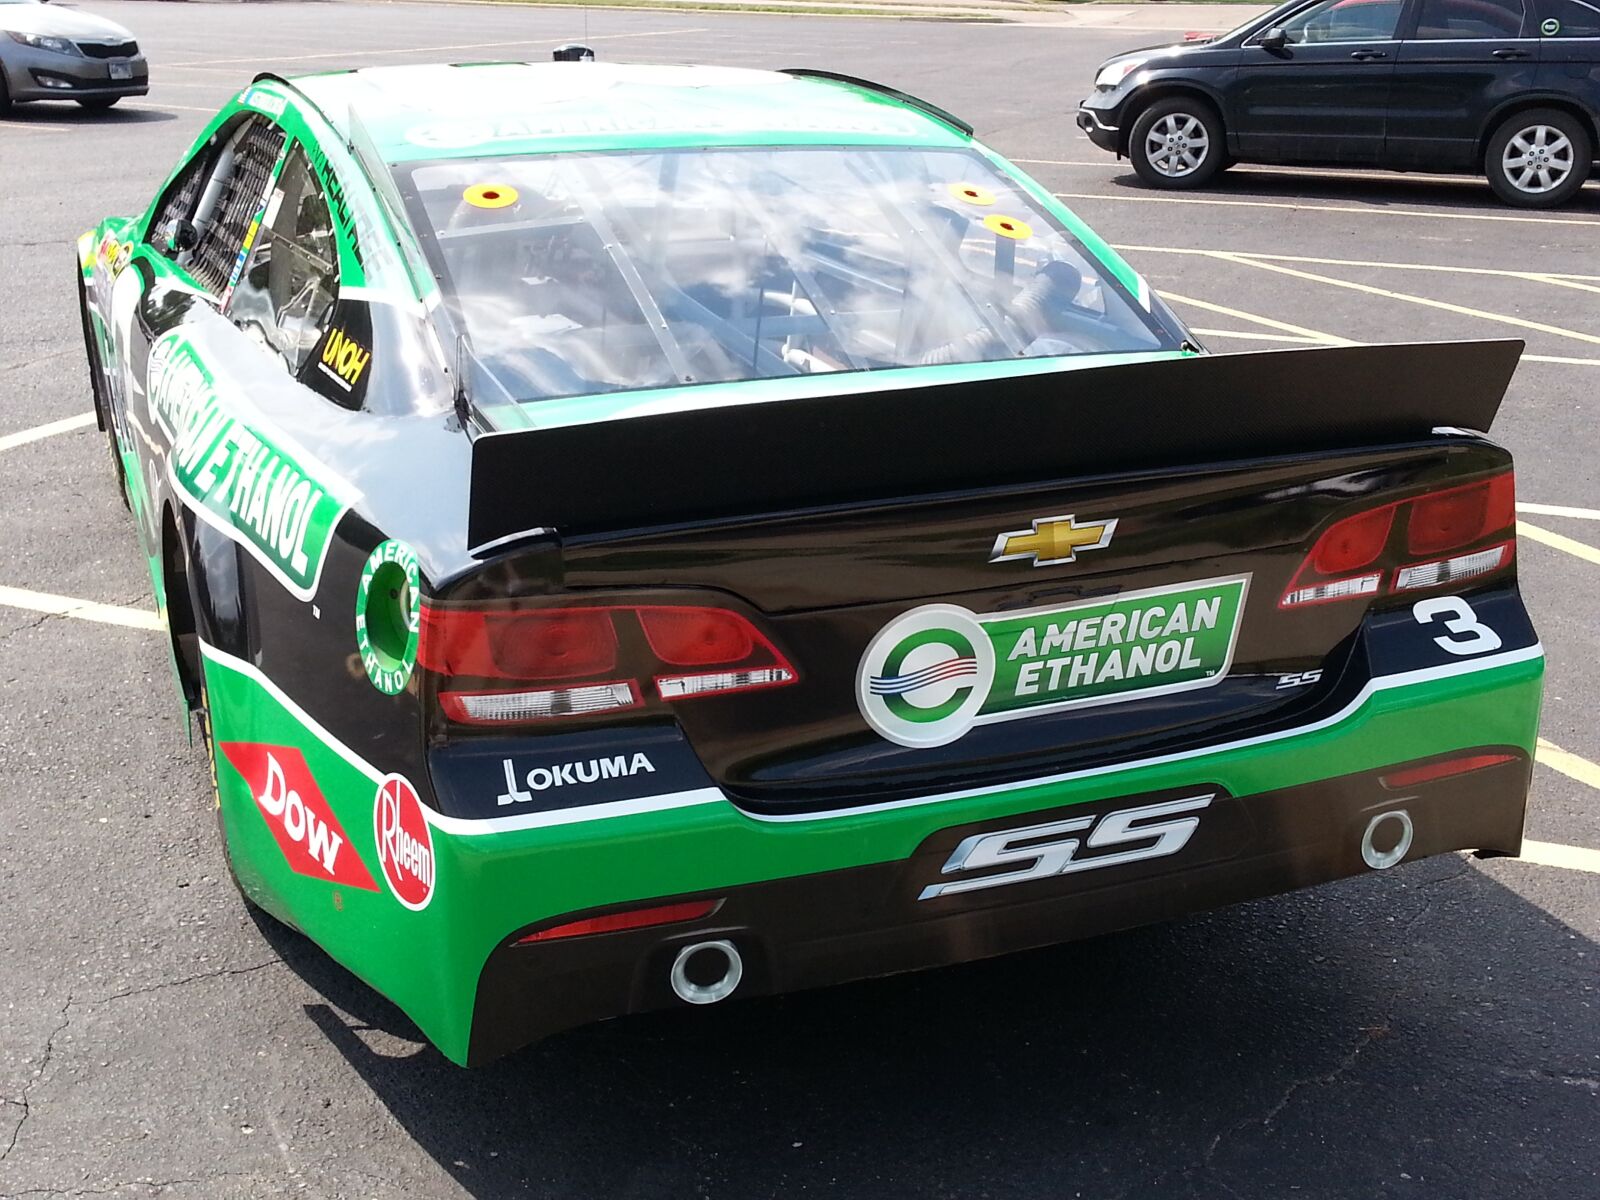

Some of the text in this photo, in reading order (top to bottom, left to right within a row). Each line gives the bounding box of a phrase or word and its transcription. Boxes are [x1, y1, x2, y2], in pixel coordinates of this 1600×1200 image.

[322, 328, 370, 385] UNOH
[194, 425, 326, 577] ETHANOL
[356, 541, 420, 693] AMERICAN ETHANOL
[1008, 596, 1221, 661] AMERICAN
[1412, 595, 1503, 656] 3
[1014, 637, 1202, 697] ETHANOL
[381, 779, 432, 888] Rheem
[917, 792, 1217, 901] SS
